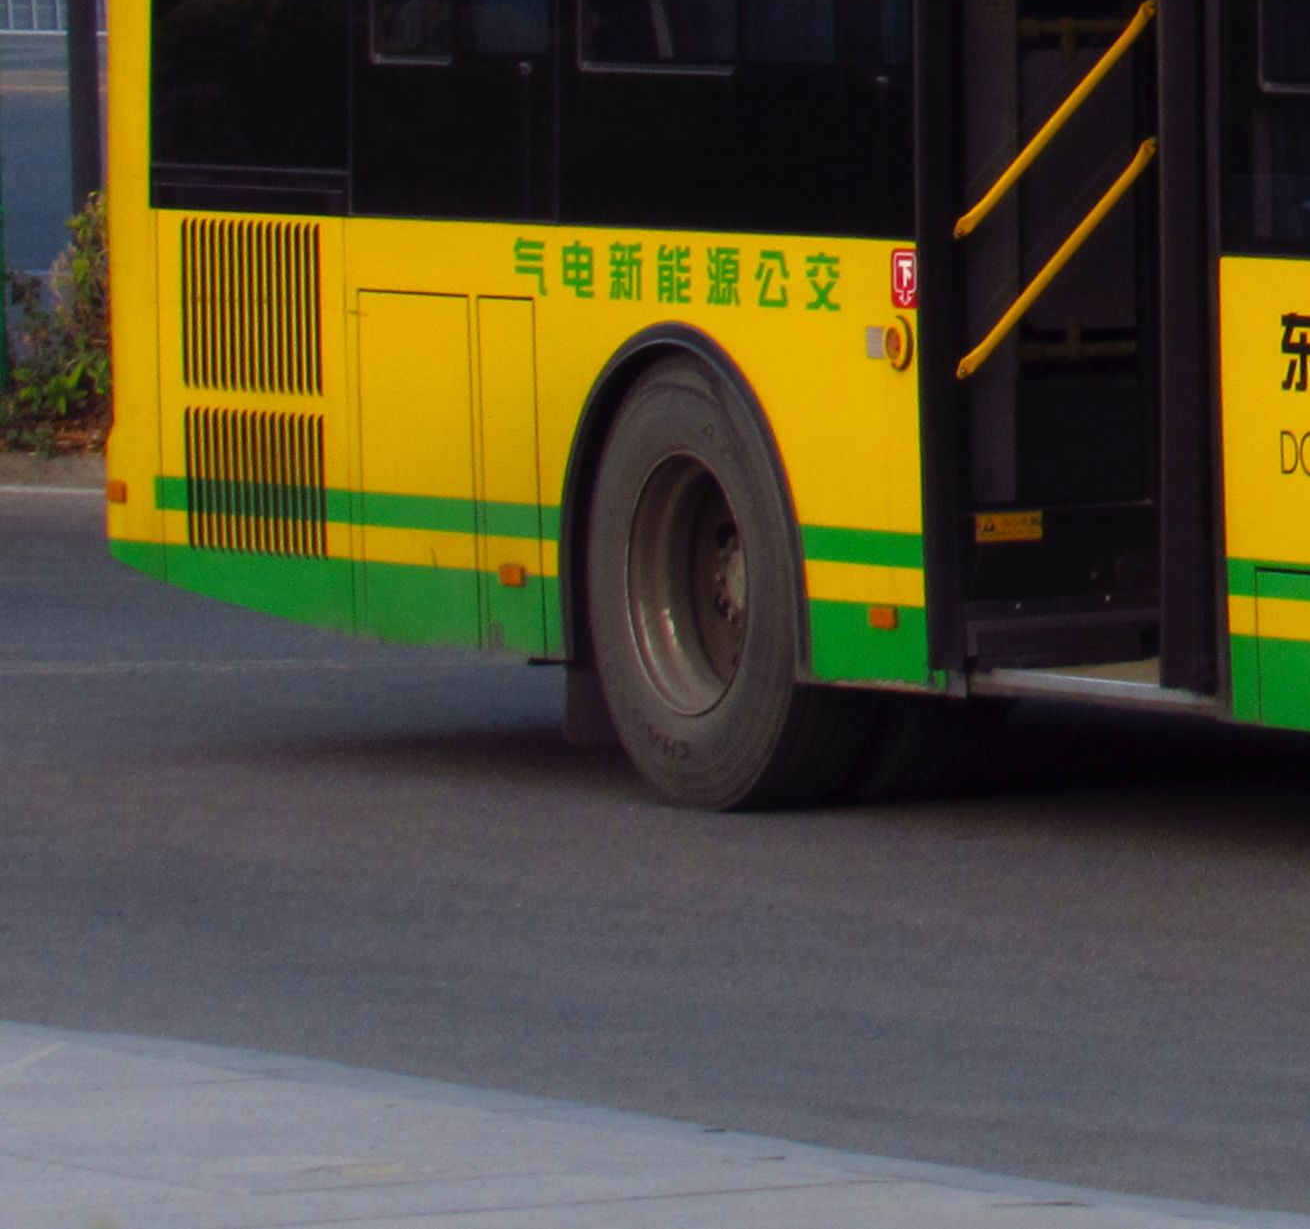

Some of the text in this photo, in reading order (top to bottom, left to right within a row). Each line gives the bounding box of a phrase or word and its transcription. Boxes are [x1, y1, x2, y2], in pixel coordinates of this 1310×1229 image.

[512, 236, 842, 312] 气电新能源公交
[896, 259, 915, 287] 下
